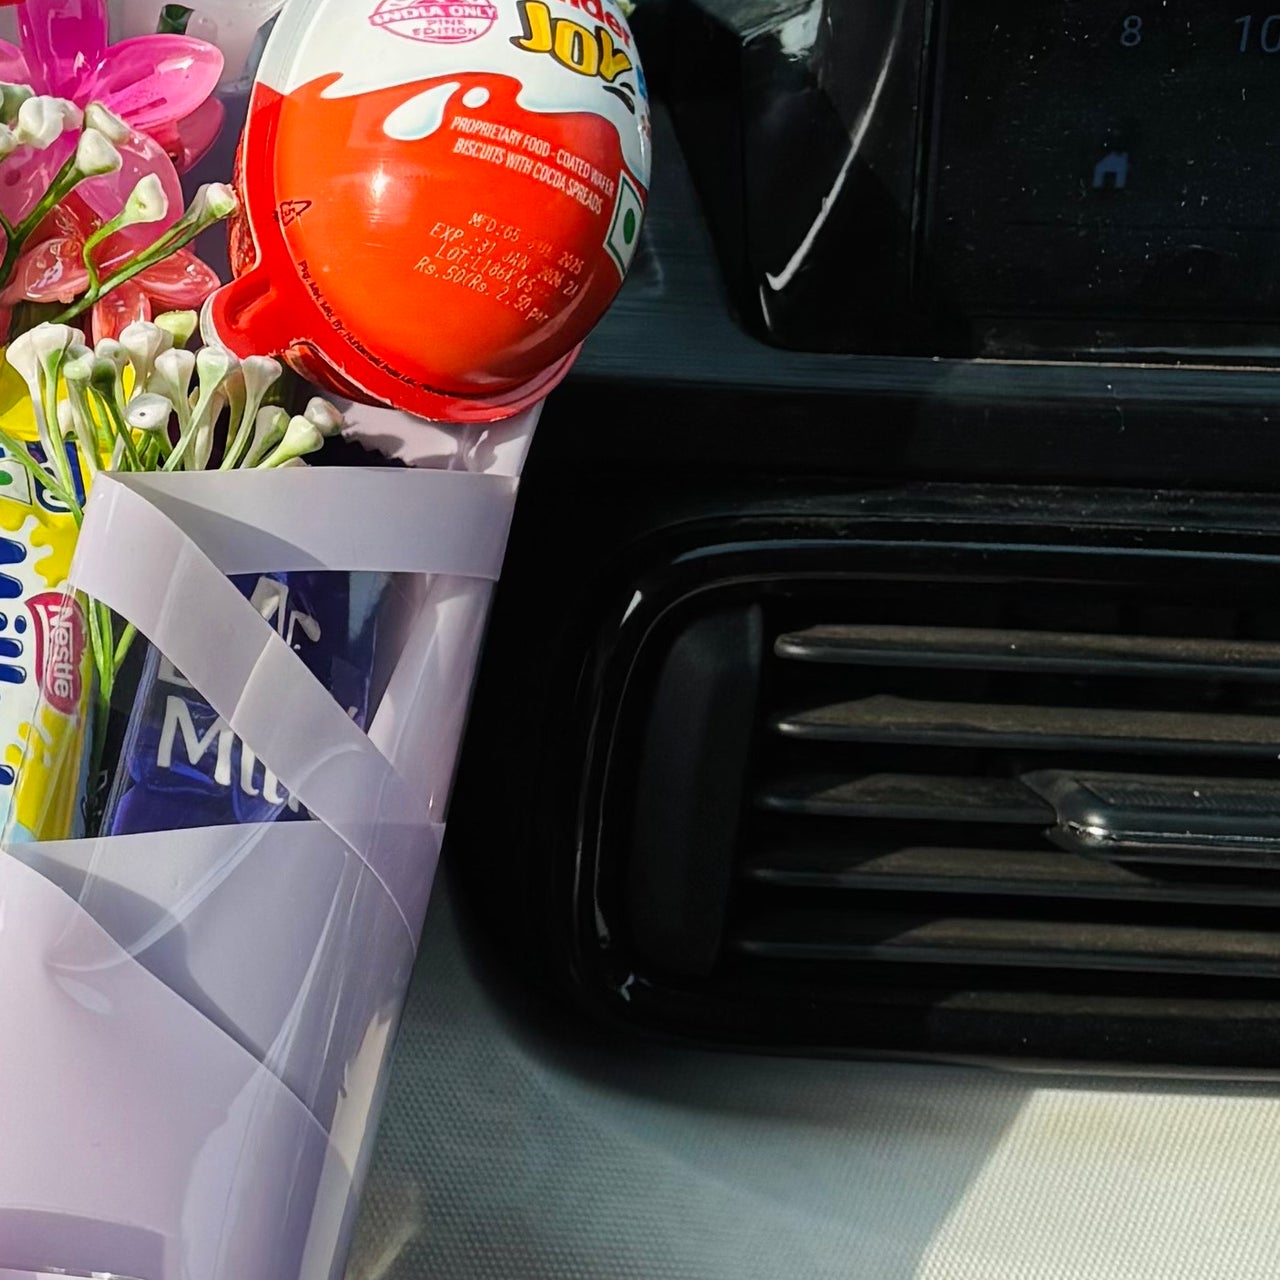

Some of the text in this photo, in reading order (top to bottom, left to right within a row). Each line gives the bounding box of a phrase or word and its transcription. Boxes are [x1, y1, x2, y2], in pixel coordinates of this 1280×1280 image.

[372, 5, 496, 24] INDIA ONLY
[411, 27, 478, 36] EDITION
[450, 116, 524, 147] PROPRIETARY
[522, 134, 551, 158] FOOD
[556, 149, 590, 180] COATED
[453, 137, 507, 165] BISCUITS
[505, 151, 534, 176] WITH
[533, 162, 567, 193] COCOA
